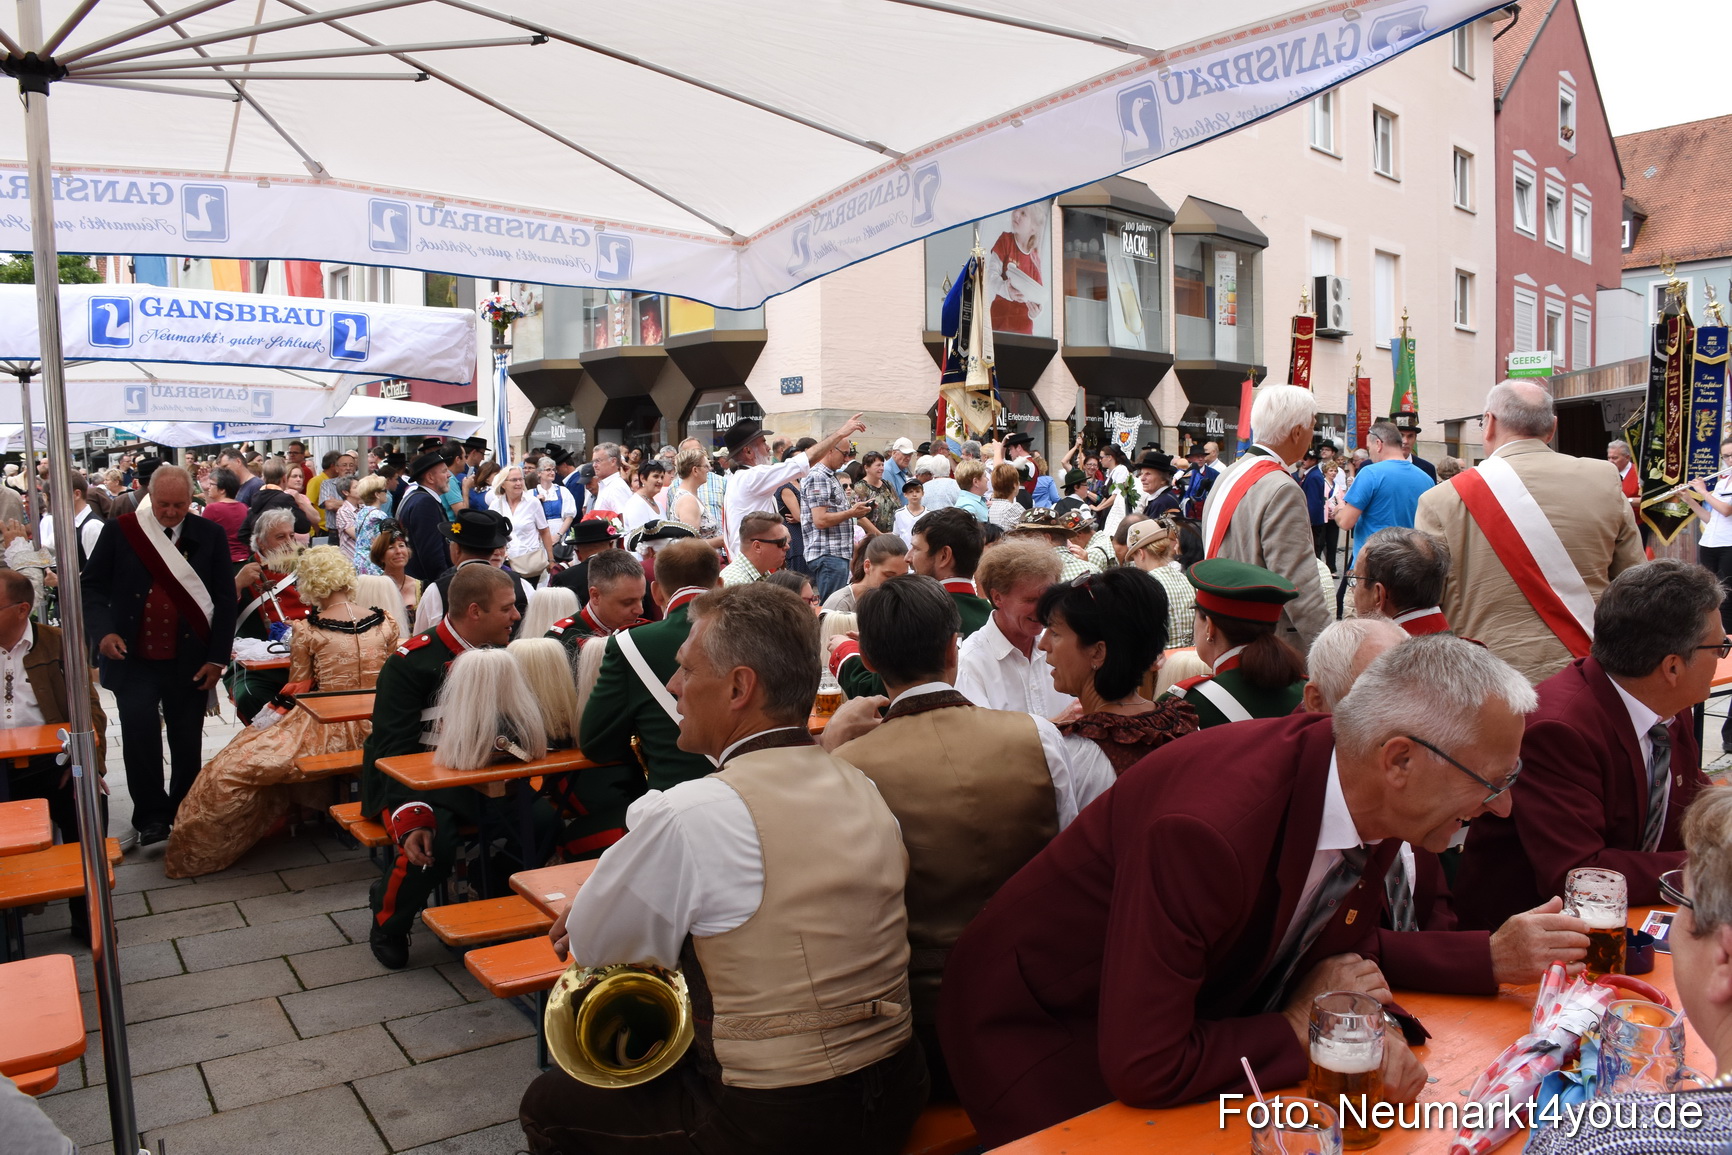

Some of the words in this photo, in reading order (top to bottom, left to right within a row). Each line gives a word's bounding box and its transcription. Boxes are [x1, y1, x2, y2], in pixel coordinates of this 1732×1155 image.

[1125, 222, 1135, 230] 100
[1136, 222, 1152, 232] Jahre
[1122, 232, 1148, 256] RACKL
[139, 296, 326, 327] GANSBRÄU
[139, 328, 224, 344] Neumarkt's
[227, 334, 265, 347] guter
[265, 335, 326, 354] Schluck
[1512, 356, 1542, 365] GEERS
[380, 379, 408, 398] Achatz
